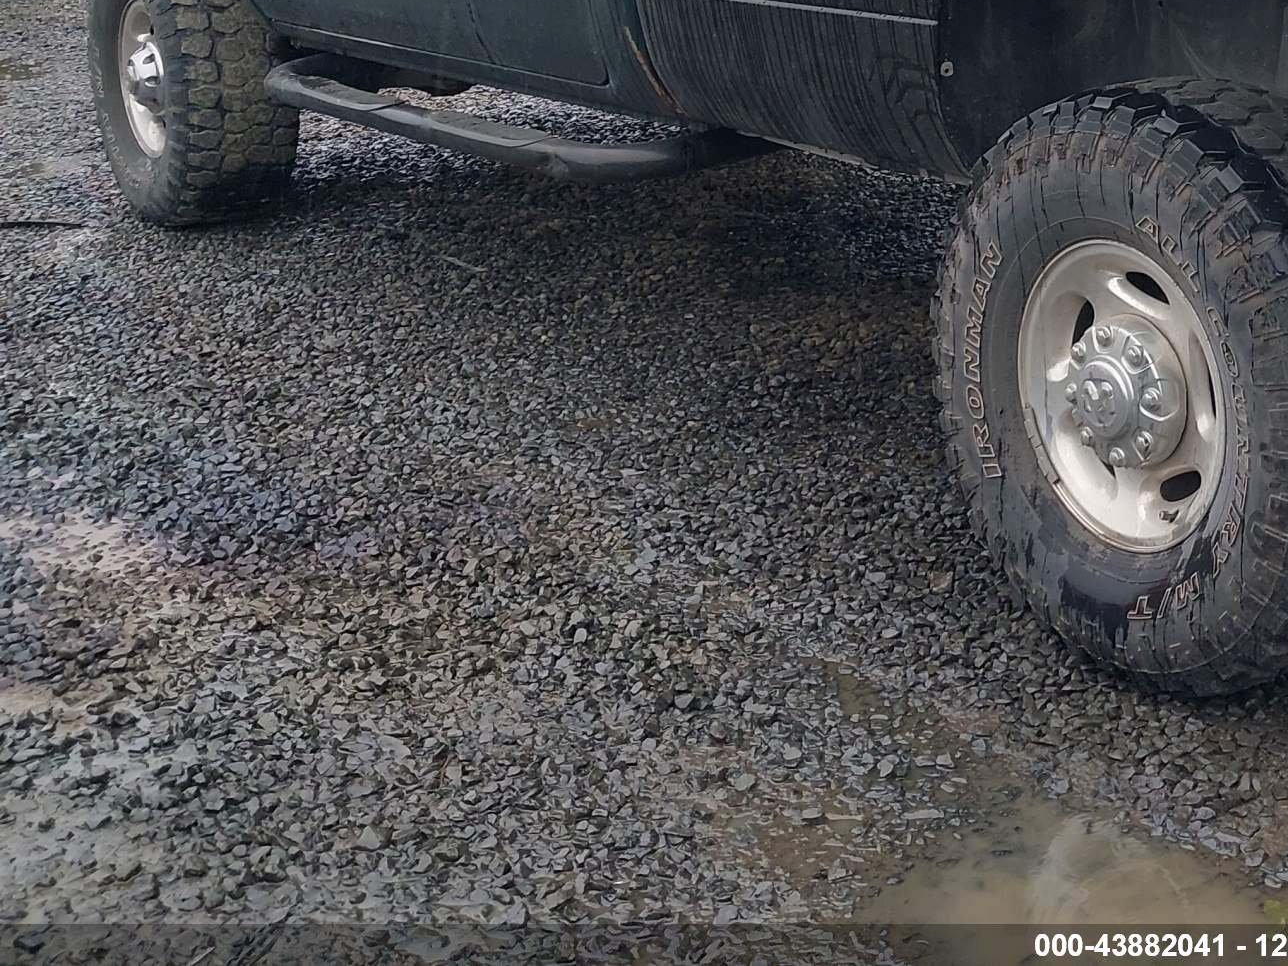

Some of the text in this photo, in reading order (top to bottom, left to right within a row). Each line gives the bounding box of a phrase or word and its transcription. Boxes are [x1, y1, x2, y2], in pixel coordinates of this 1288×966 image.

[962, 241, 1002, 478] IRONMAN
[1126, 216, 1251, 620] ALL COUNTRY M/T
